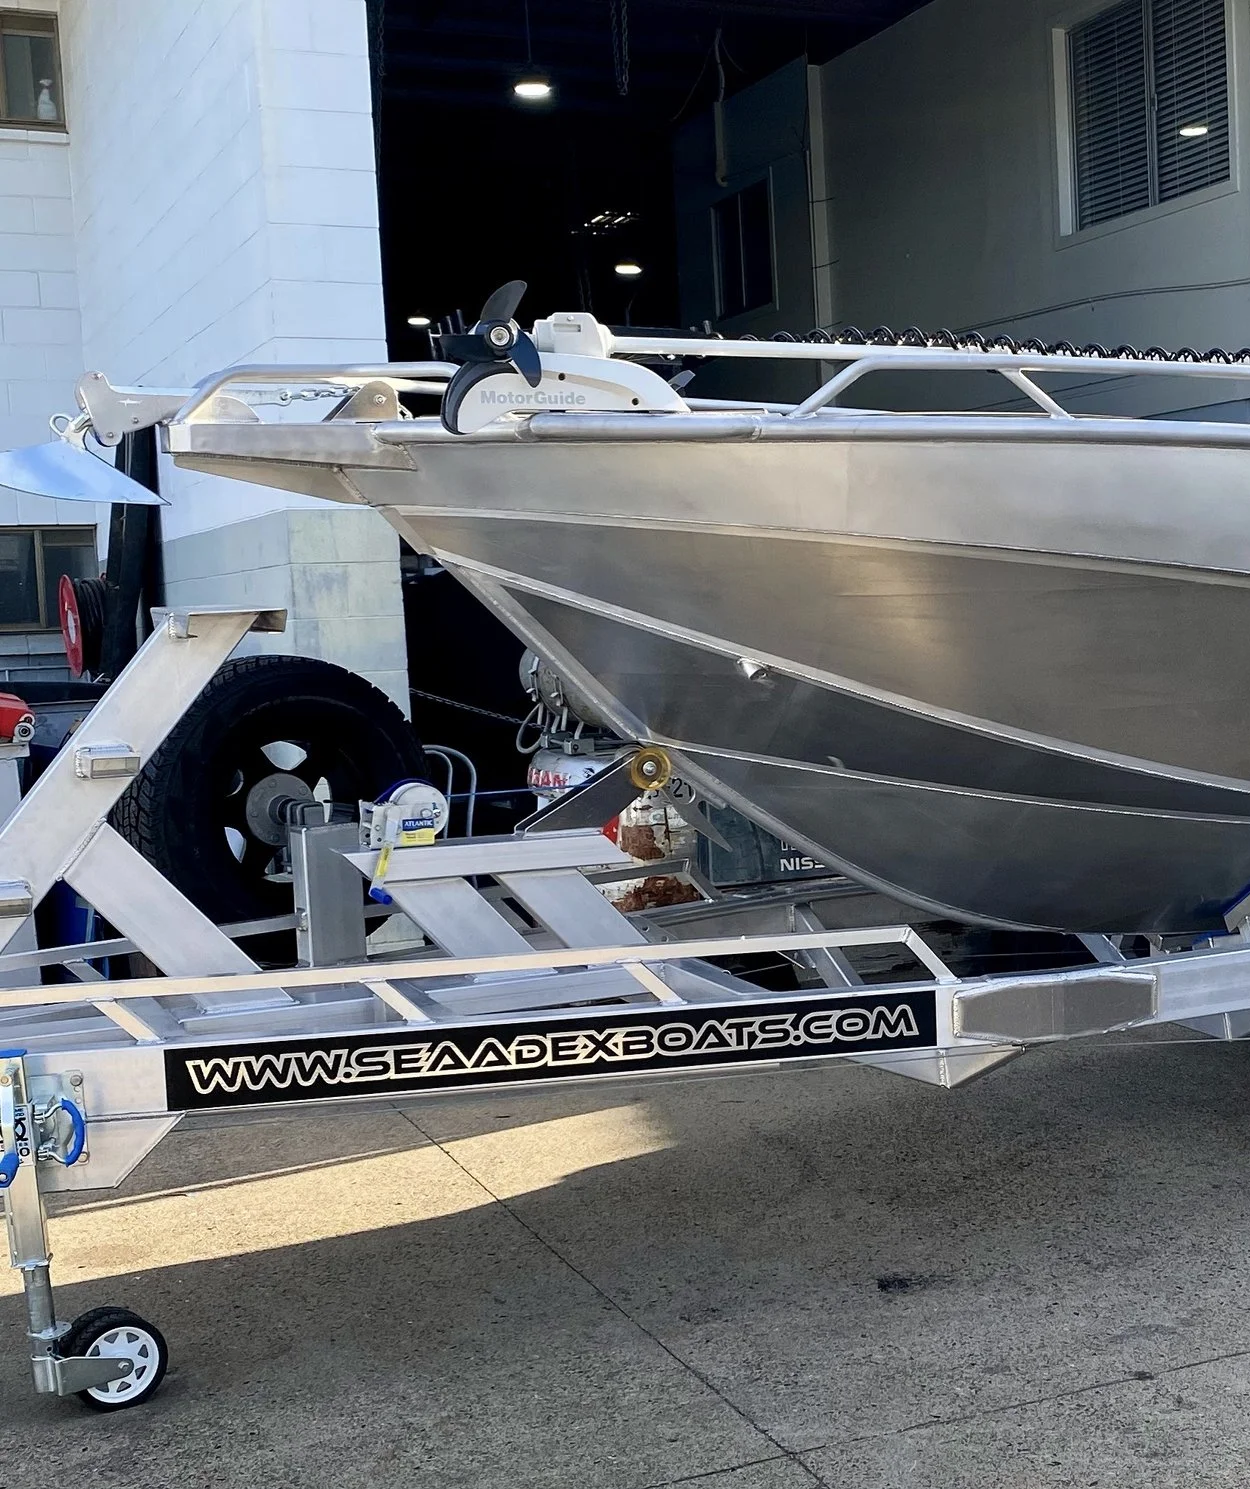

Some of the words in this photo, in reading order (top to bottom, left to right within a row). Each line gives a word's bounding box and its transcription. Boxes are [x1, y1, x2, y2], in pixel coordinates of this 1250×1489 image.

[480, 390, 586, 405] MotorGuide
[404, 820, 433, 828] ATLANTIC
[186, 1005, 918, 1094] WWW.SEAADEXBOATS.COM
